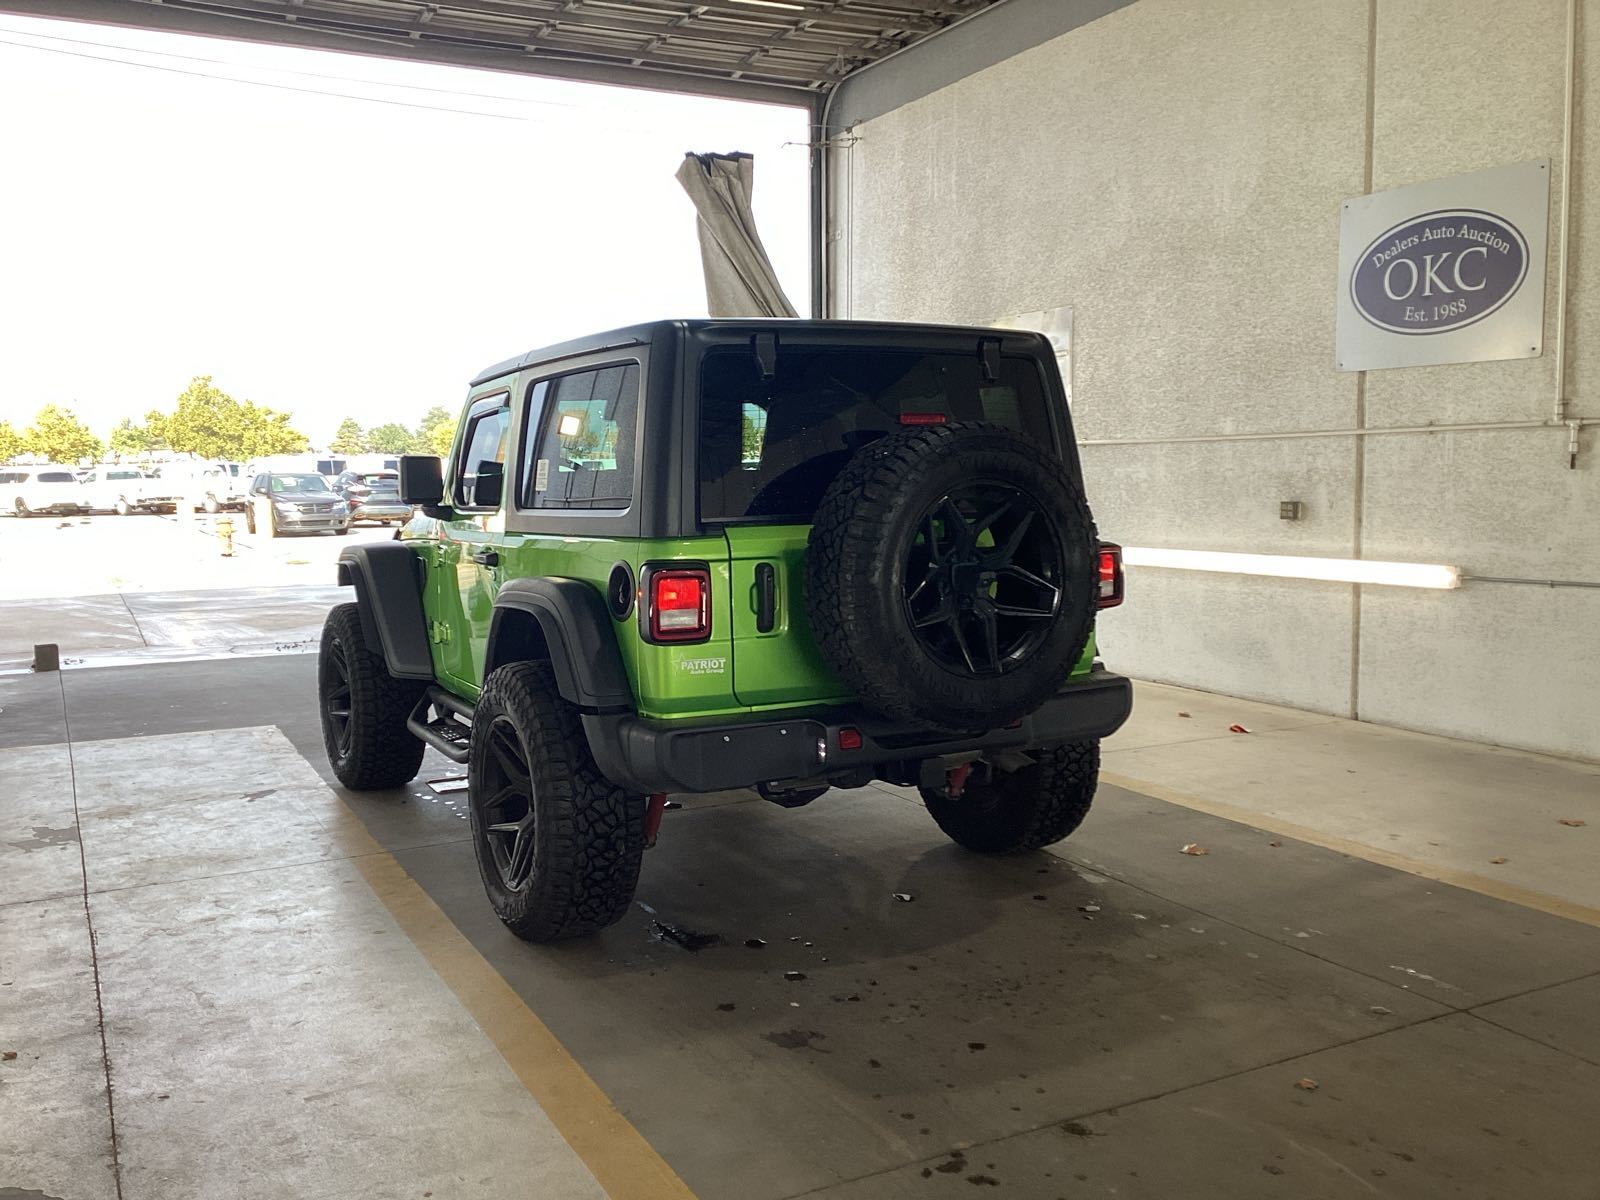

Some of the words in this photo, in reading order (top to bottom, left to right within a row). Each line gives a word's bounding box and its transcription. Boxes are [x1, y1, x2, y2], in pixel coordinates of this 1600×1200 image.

[1372, 234, 1420, 268] Dealers
[1422, 227, 1455, 242] Auto
[1457, 224, 1510, 254] Auction
[1384, 247, 1488, 300] OKC
[1404, 306, 1428, 321] Est.
[1433, 299, 1467, 321] 1988
[681, 659, 726, 670] PATRIOT
